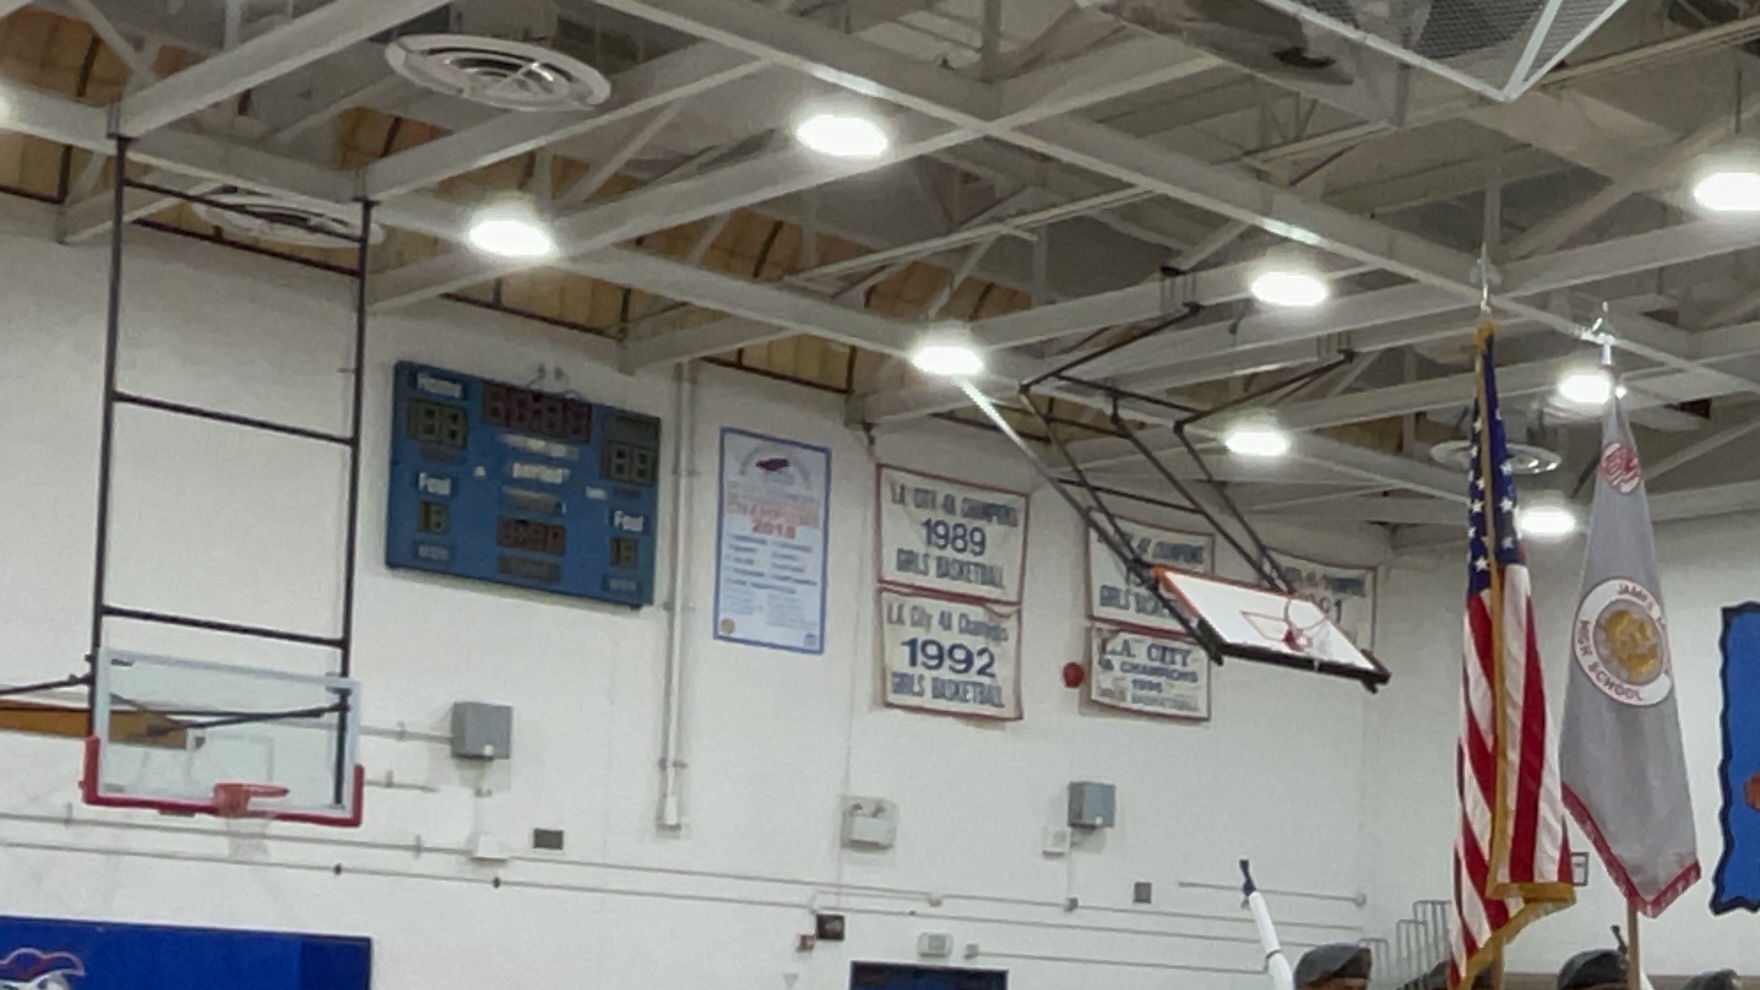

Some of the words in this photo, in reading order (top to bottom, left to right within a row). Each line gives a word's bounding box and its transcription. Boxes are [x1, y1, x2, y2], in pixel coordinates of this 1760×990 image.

[922, 518, 986, 557] 1989
[896, 547, 930, 577] GIRLS
[935, 556, 1004, 589] BASKETBALL
[900, 637, 997, 679] 1992
[1146, 642, 1193, 668] CITY
[891, 671, 926, 698] GIRLS
[930, 676, 1006, 709] BASKETBALL
